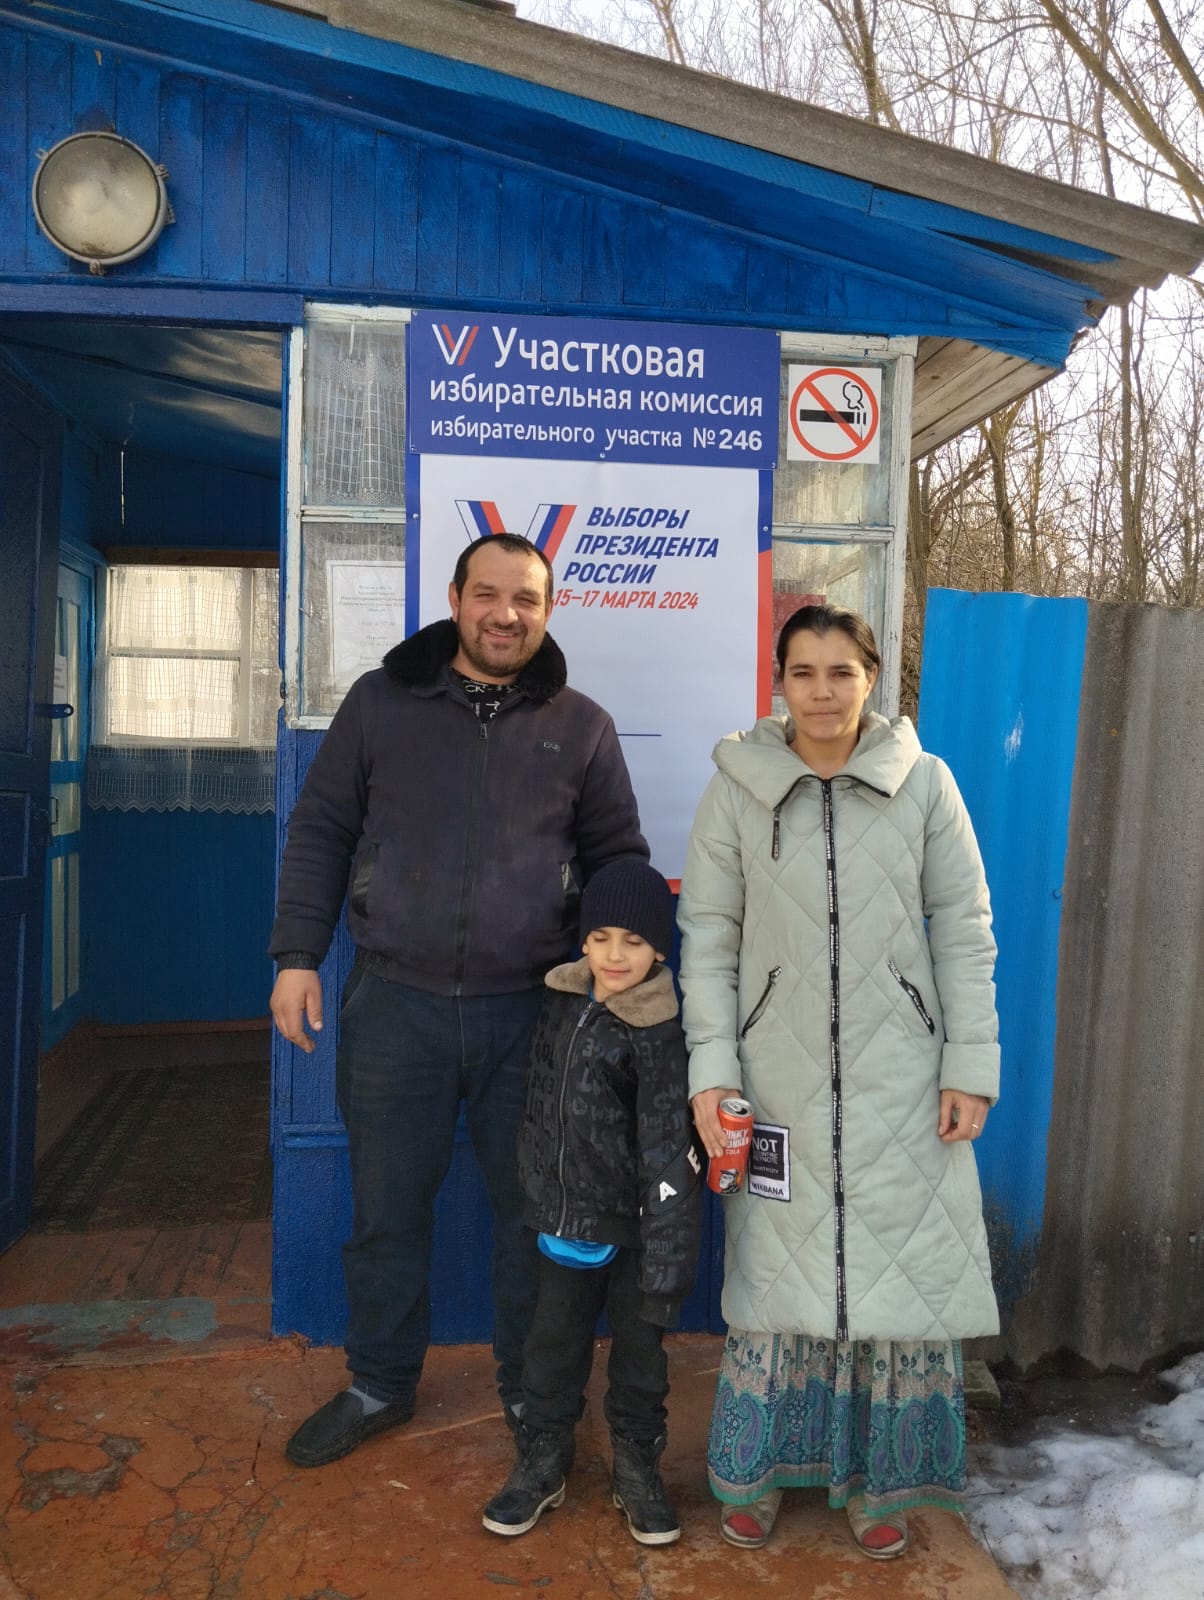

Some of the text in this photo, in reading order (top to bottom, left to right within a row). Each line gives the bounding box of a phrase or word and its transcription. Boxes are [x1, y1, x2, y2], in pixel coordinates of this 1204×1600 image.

[491, 326, 705, 379] Участковая
[430, 373, 763, 417] избирательная комиссия
[431, 415, 595, 444] избирательного
[604, 427, 682, 450] участка
[586, 506, 691, 529] ВЫБОРЫ
[574, 533, 720, 559] ПРЕЗИДЕНТА
[562, 561, 658, 585] РОССИИ
[599, 590, 655, 609] МАРТА
[657, 591, 699, 610] 2024
[752, 1136, 778, 1153] NOT
